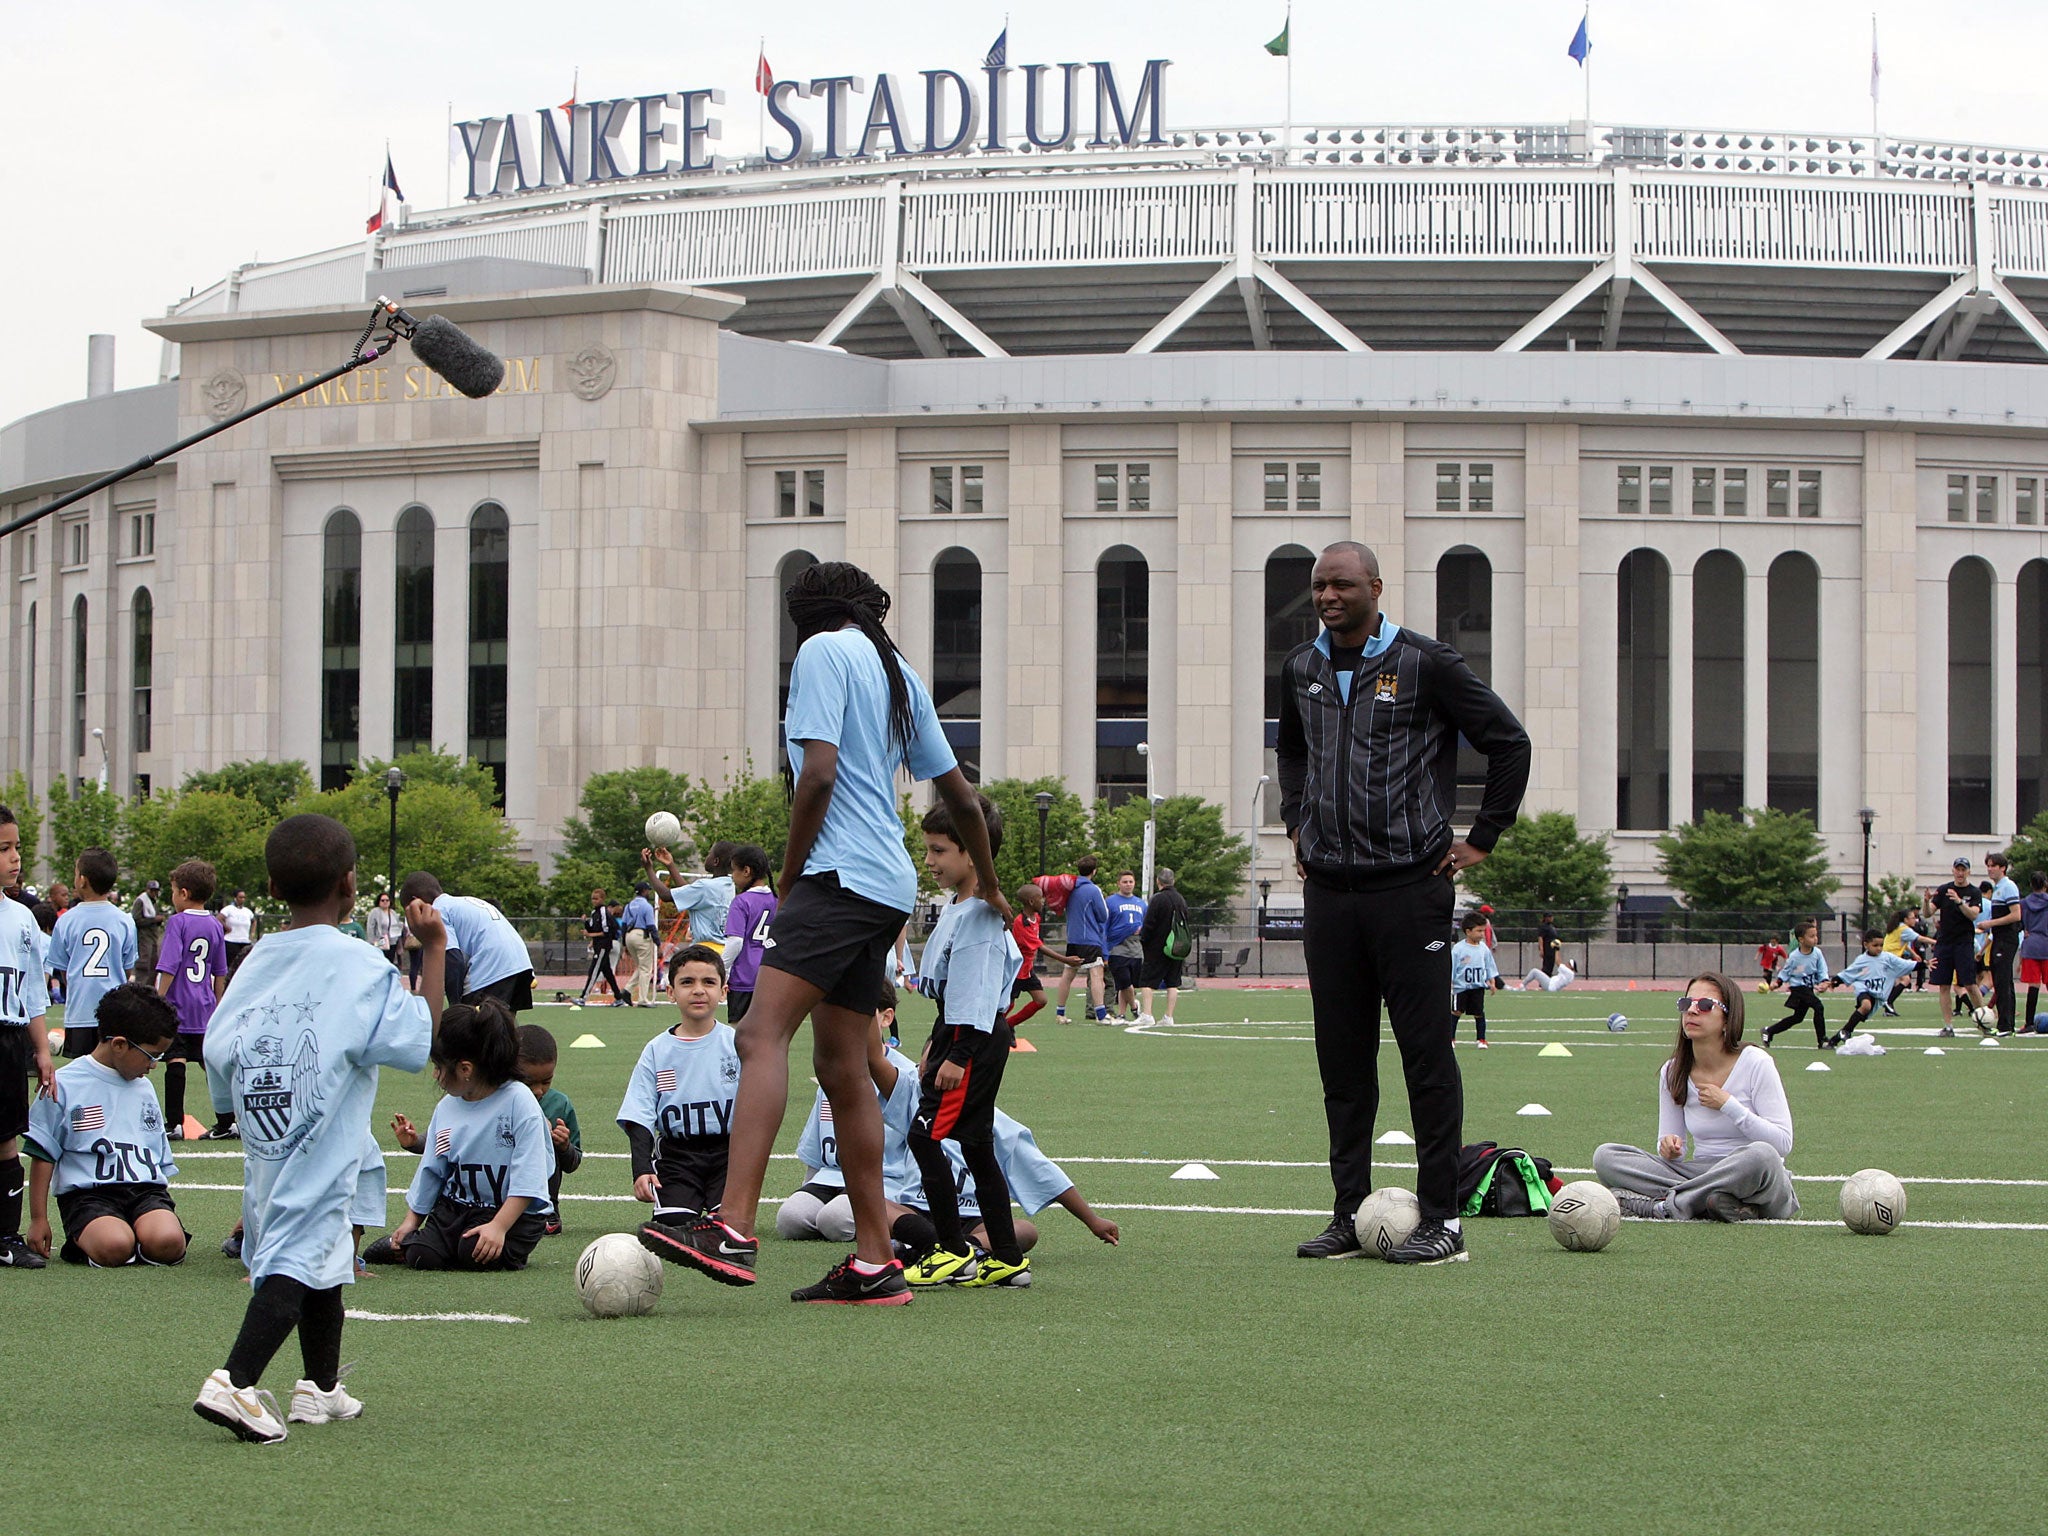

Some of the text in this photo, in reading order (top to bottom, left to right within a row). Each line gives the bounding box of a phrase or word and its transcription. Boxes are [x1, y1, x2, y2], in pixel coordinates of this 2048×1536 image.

[453, 59, 1174, 200] YANKEE STADIUM
[751, 909, 770, 946] 4
[82, 928, 110, 977] 2
[186, 937, 209, 983] 3
[1465, 967, 1485, 983] CIT
[247, 1094, 288, 1108] M.C.F.C.
[660, 1098, 734, 1138] CITY
[91, 1137, 157, 1181] CITY
